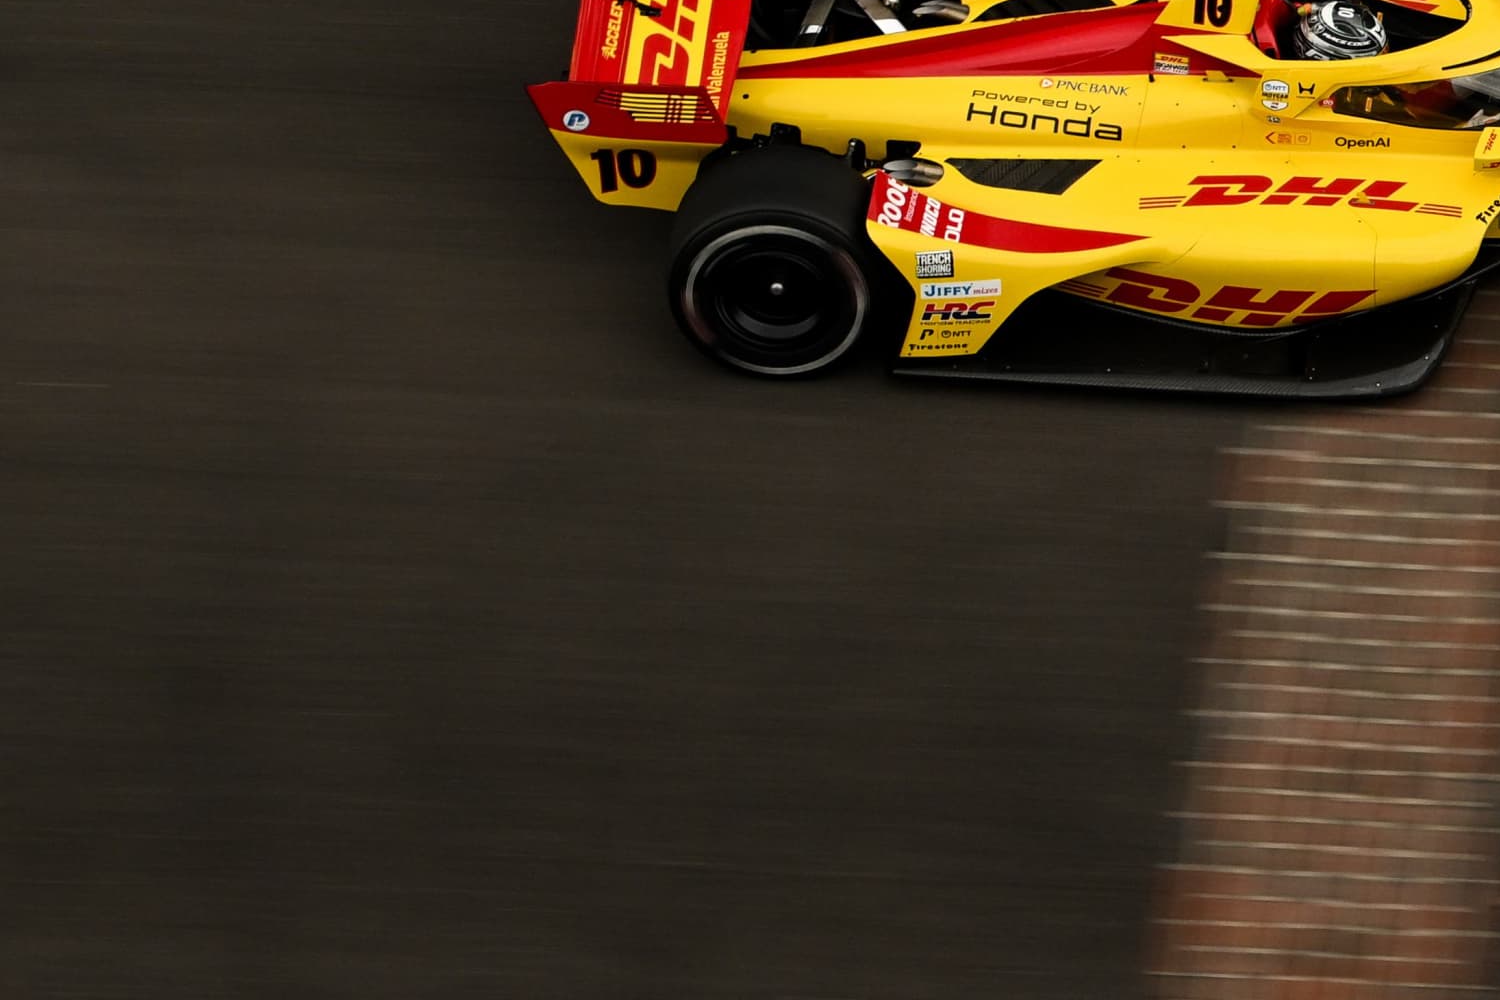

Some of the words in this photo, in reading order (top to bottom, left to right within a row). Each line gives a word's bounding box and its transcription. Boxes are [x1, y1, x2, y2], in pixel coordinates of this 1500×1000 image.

[706, 31, 730, 94] Valenzuela
[1056, 80, 1089, 92] PNC
[1089, 82, 1129, 96] BANK
[971, 89, 1068, 109] Powered
[1075, 100, 1101, 114] by
[966, 102, 1122, 141] Honda
[1334, 137, 1390, 149] OpenAI
[590, 149, 657, 194] 10
[1182, 175, 1419, 212] DHL
[916, 253, 951, 265] TRENCH
[916, 263, 951, 273] SHORING
[924, 285, 971, 296] JIFFY
[1102, 267, 1378, 326] DHL
[921, 301, 995, 320] HRC
[908, 343, 968, 351] Firestone
